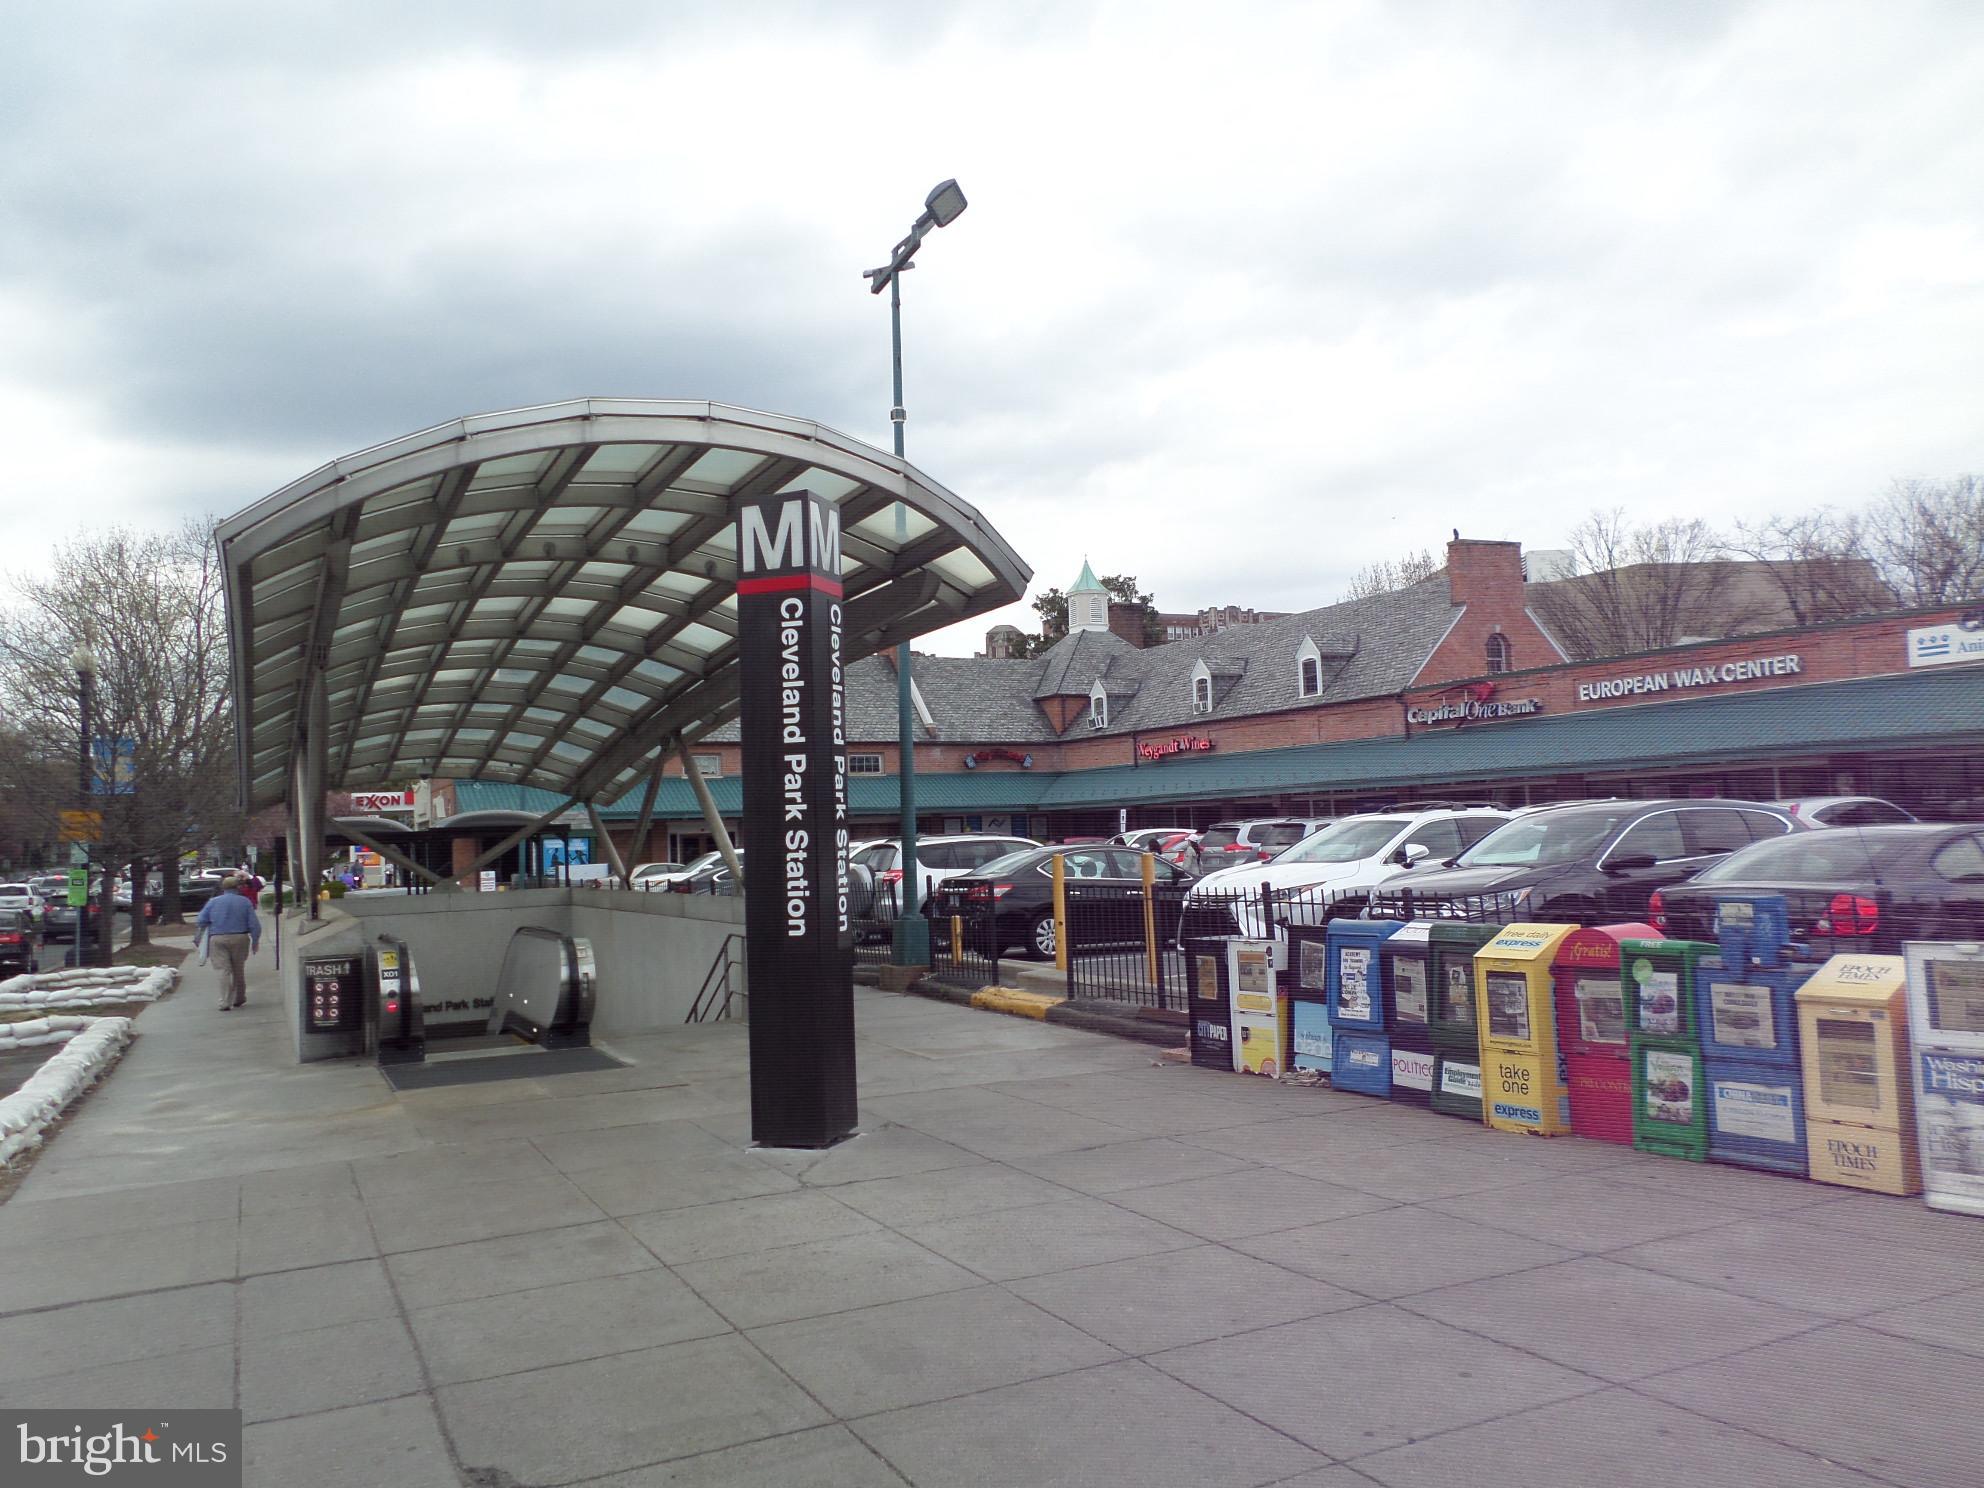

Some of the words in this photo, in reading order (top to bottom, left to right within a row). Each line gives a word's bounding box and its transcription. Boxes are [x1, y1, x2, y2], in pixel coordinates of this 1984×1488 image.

[741, 500, 804, 572] M
[809, 500, 840, 575] M
[1956, 638, 1984, 654] Ani
[780, 597, 806, 743] Cleveland
[830, 603, 845, 746] Cleveland
[1579, 672, 1669, 700] EUROPEAN
[1674, 663, 1719, 688] WAX
[1721, 654, 1800, 682] CENTER
[1136, 738, 1179, 760] Weygandt
[1180, 736, 1211, 751] Wines
[784, 754, 808, 822] Park
[834, 755, 846, 820] Park
[355, 794, 401, 810] EXXON
[785, 830, 810, 937] Station
[836, 828, 850, 932] Station
[1494, 939, 1543, 948] express
[1503, 930, 1525, 939] free
[1528, 931, 1554, 940] daily
[1639, 940, 1663, 949] FREE
[305, 962, 343, 976] TRASH
[1837, 971, 1882, 982] TIMES
[1839, 964, 1892, 974] EPOCH
[445, 999, 469, 1012] Park
[1499, 1063, 1530, 1081] take
[1926, 1056, 1984, 1074] Washi
[1502, 1079, 1530, 1096] one
[1494, 1103, 1540, 1121] express
[1827, 1138, 1879, 1158] EPOCH
[1832, 1151, 1877, 1171] TIMES
